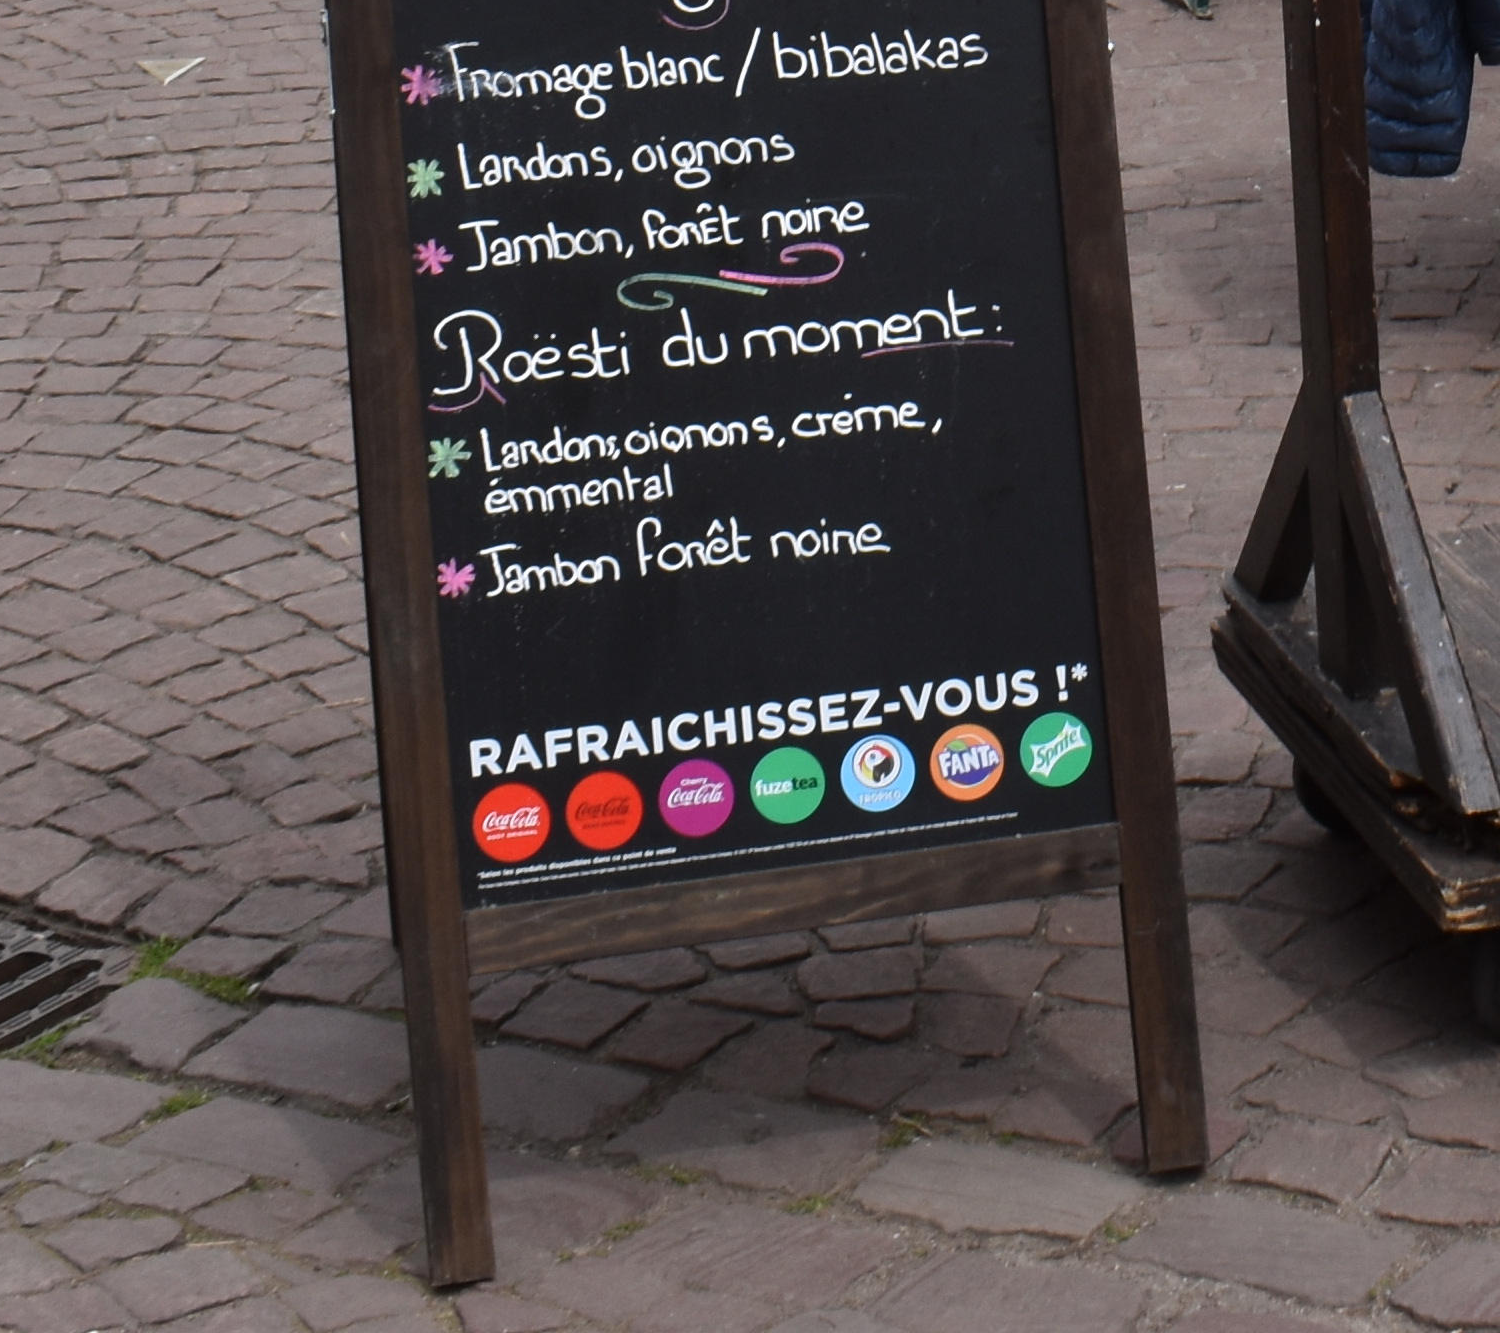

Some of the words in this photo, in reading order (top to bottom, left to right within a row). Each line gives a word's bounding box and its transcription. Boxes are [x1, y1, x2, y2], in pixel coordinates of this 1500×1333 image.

[620, 43, 725, 90] blanc
[734, 27, 762, 97] /
[773, 29, 989, 81] bibalakas
[631, 132, 795, 189] oignons
[761, 199, 871, 237] noire
[661, 307, 729, 369] du
[479, 543, 621, 598] Jambon
[636, 516, 752, 579] forêt
[770, 518, 891, 558] noire
[469, 669, 1039, 777] RAFRAICHISSEZ-VOUS
[1034, 725, 1079, 769] Sprite
[755, 774, 819, 797] fuzetea
[937, 743, 1001, 779] FANTA
[515, 864, 547, 876] produits
[548, 858, 592, 870] disponibles
